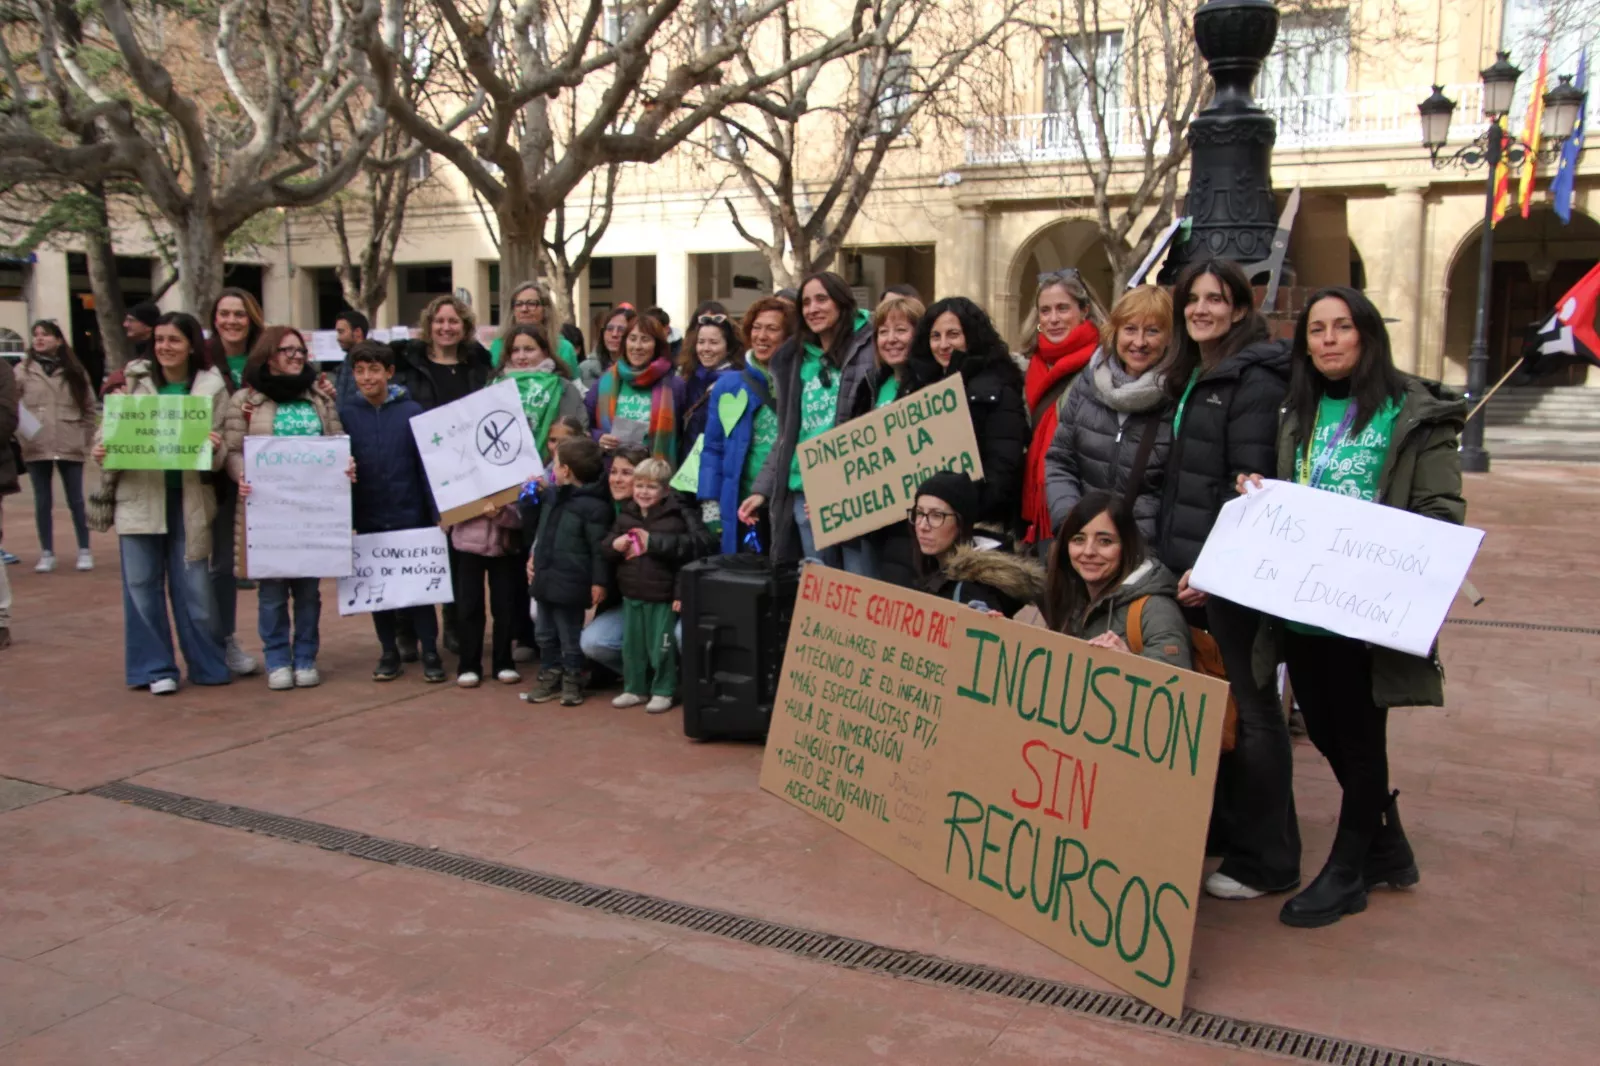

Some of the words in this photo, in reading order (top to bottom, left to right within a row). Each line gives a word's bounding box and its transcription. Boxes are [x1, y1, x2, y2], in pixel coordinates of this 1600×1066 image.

[135, 428, 160, 436] PARA
[150, 407, 207, 420] PÚBLICO
[803, 425, 877, 470] DINERO
[883, 388, 958, 437] PÚBLICO
[106, 443, 155, 455] ESCUELA
[325, 449, 337, 467] 3
[843, 446, 897, 485] PARA
[906, 427, 934, 455] LA
[819, 483, 896, 535] ESCUELA
[901, 452, 975, 500] PÚBICA
[371, 546, 447, 560] CONCIERTOS
[380, 566, 396, 576] DE
[401, 561, 447, 576] MÚSICA
[1326, 527, 1431, 577] INVERSIÓN
[801, 573, 821, 601] EN
[824, 581, 862, 619] ESTE
[865, 593, 924, 639] CENTRO
[882, 645, 897, 664] DE
[822, 679, 910, 735] ESPECIALISTAS
[859, 667, 872, 688] DE
[878, 673, 896, 697] ED.
[956, 628, 1207, 777] INCLUSIÓN
[786, 698, 814, 725] AULA
[815, 708, 832, 735] DE
[836, 716, 904, 764] INMERSIÓN
[784, 778, 846, 823] ADECUADO
[816, 766, 833, 792] DE
[835, 774, 890, 823] INFANTIL
[1011, 739, 1099, 830] SIN
[943, 790, 1190, 989] RECURSOS
